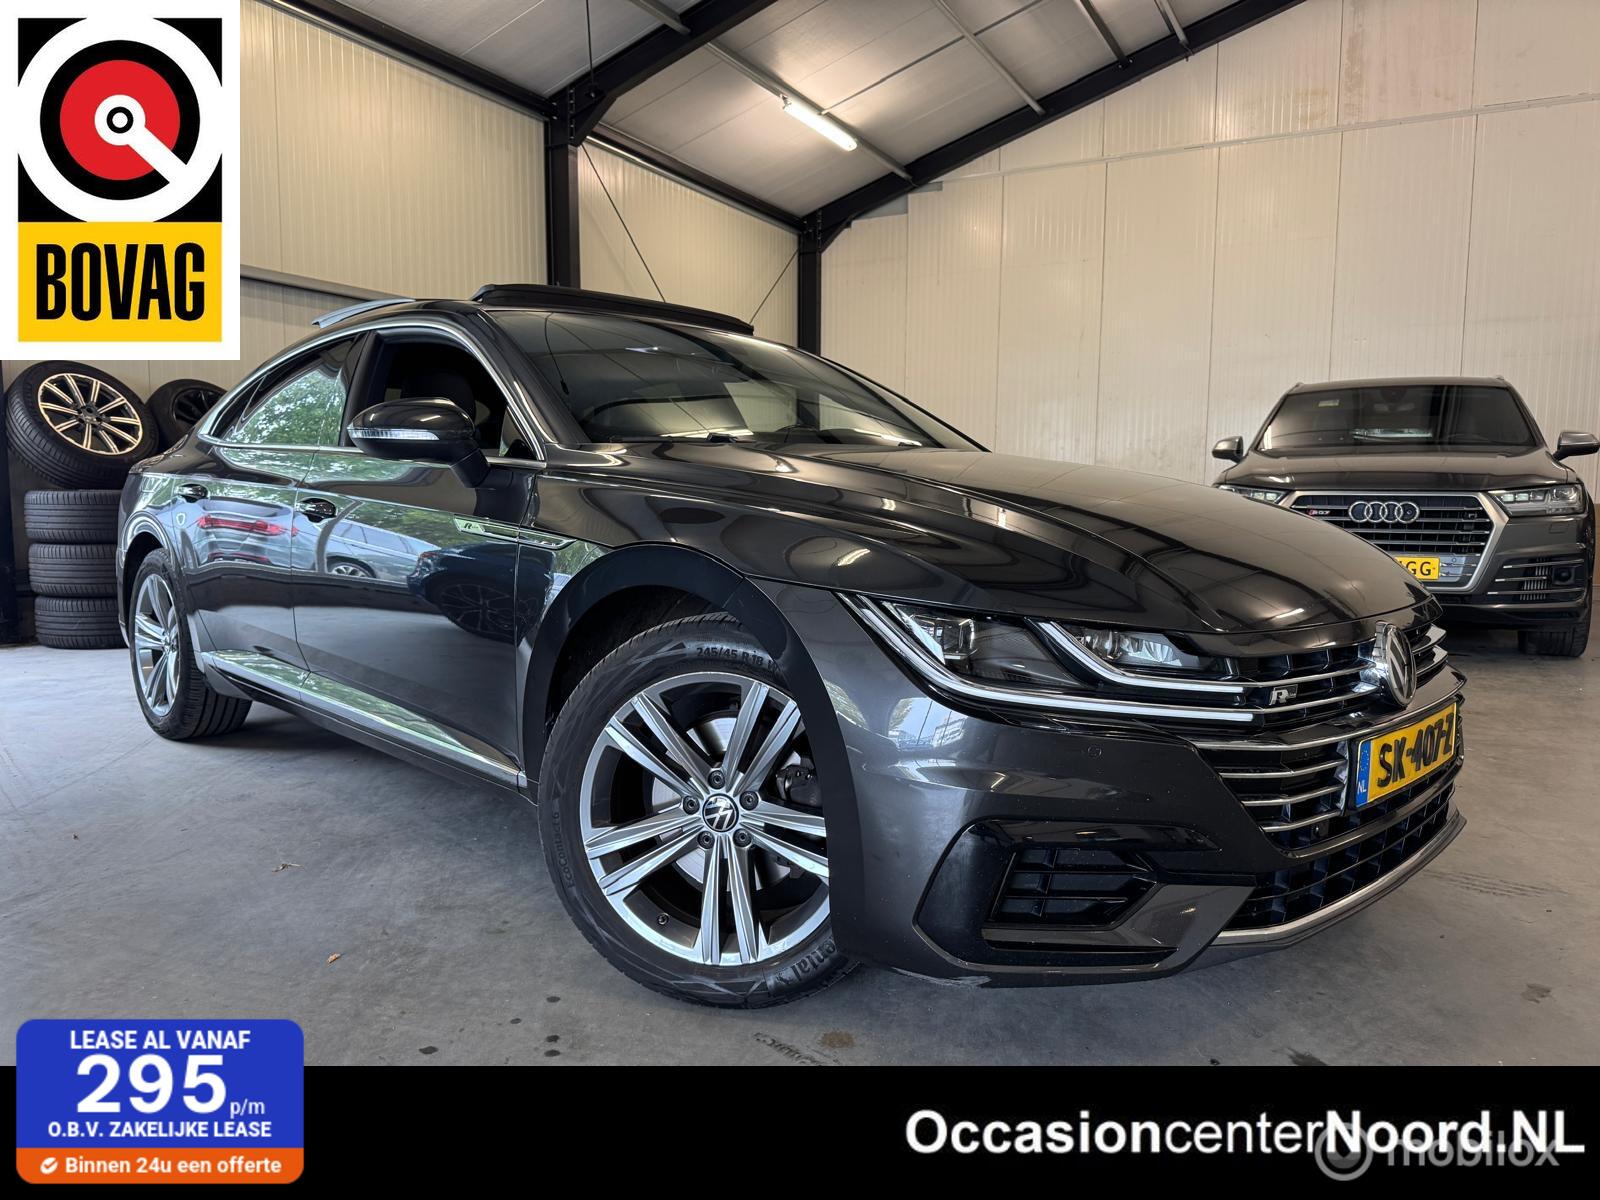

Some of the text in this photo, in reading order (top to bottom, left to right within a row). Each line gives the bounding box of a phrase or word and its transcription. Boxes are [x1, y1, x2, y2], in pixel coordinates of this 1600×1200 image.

[1400, 560, 1431, 576] GG
[697, 647, 738, 659] 245/45
[741, 651, 750, 662] R
[752, 653, 764, 666] 18
